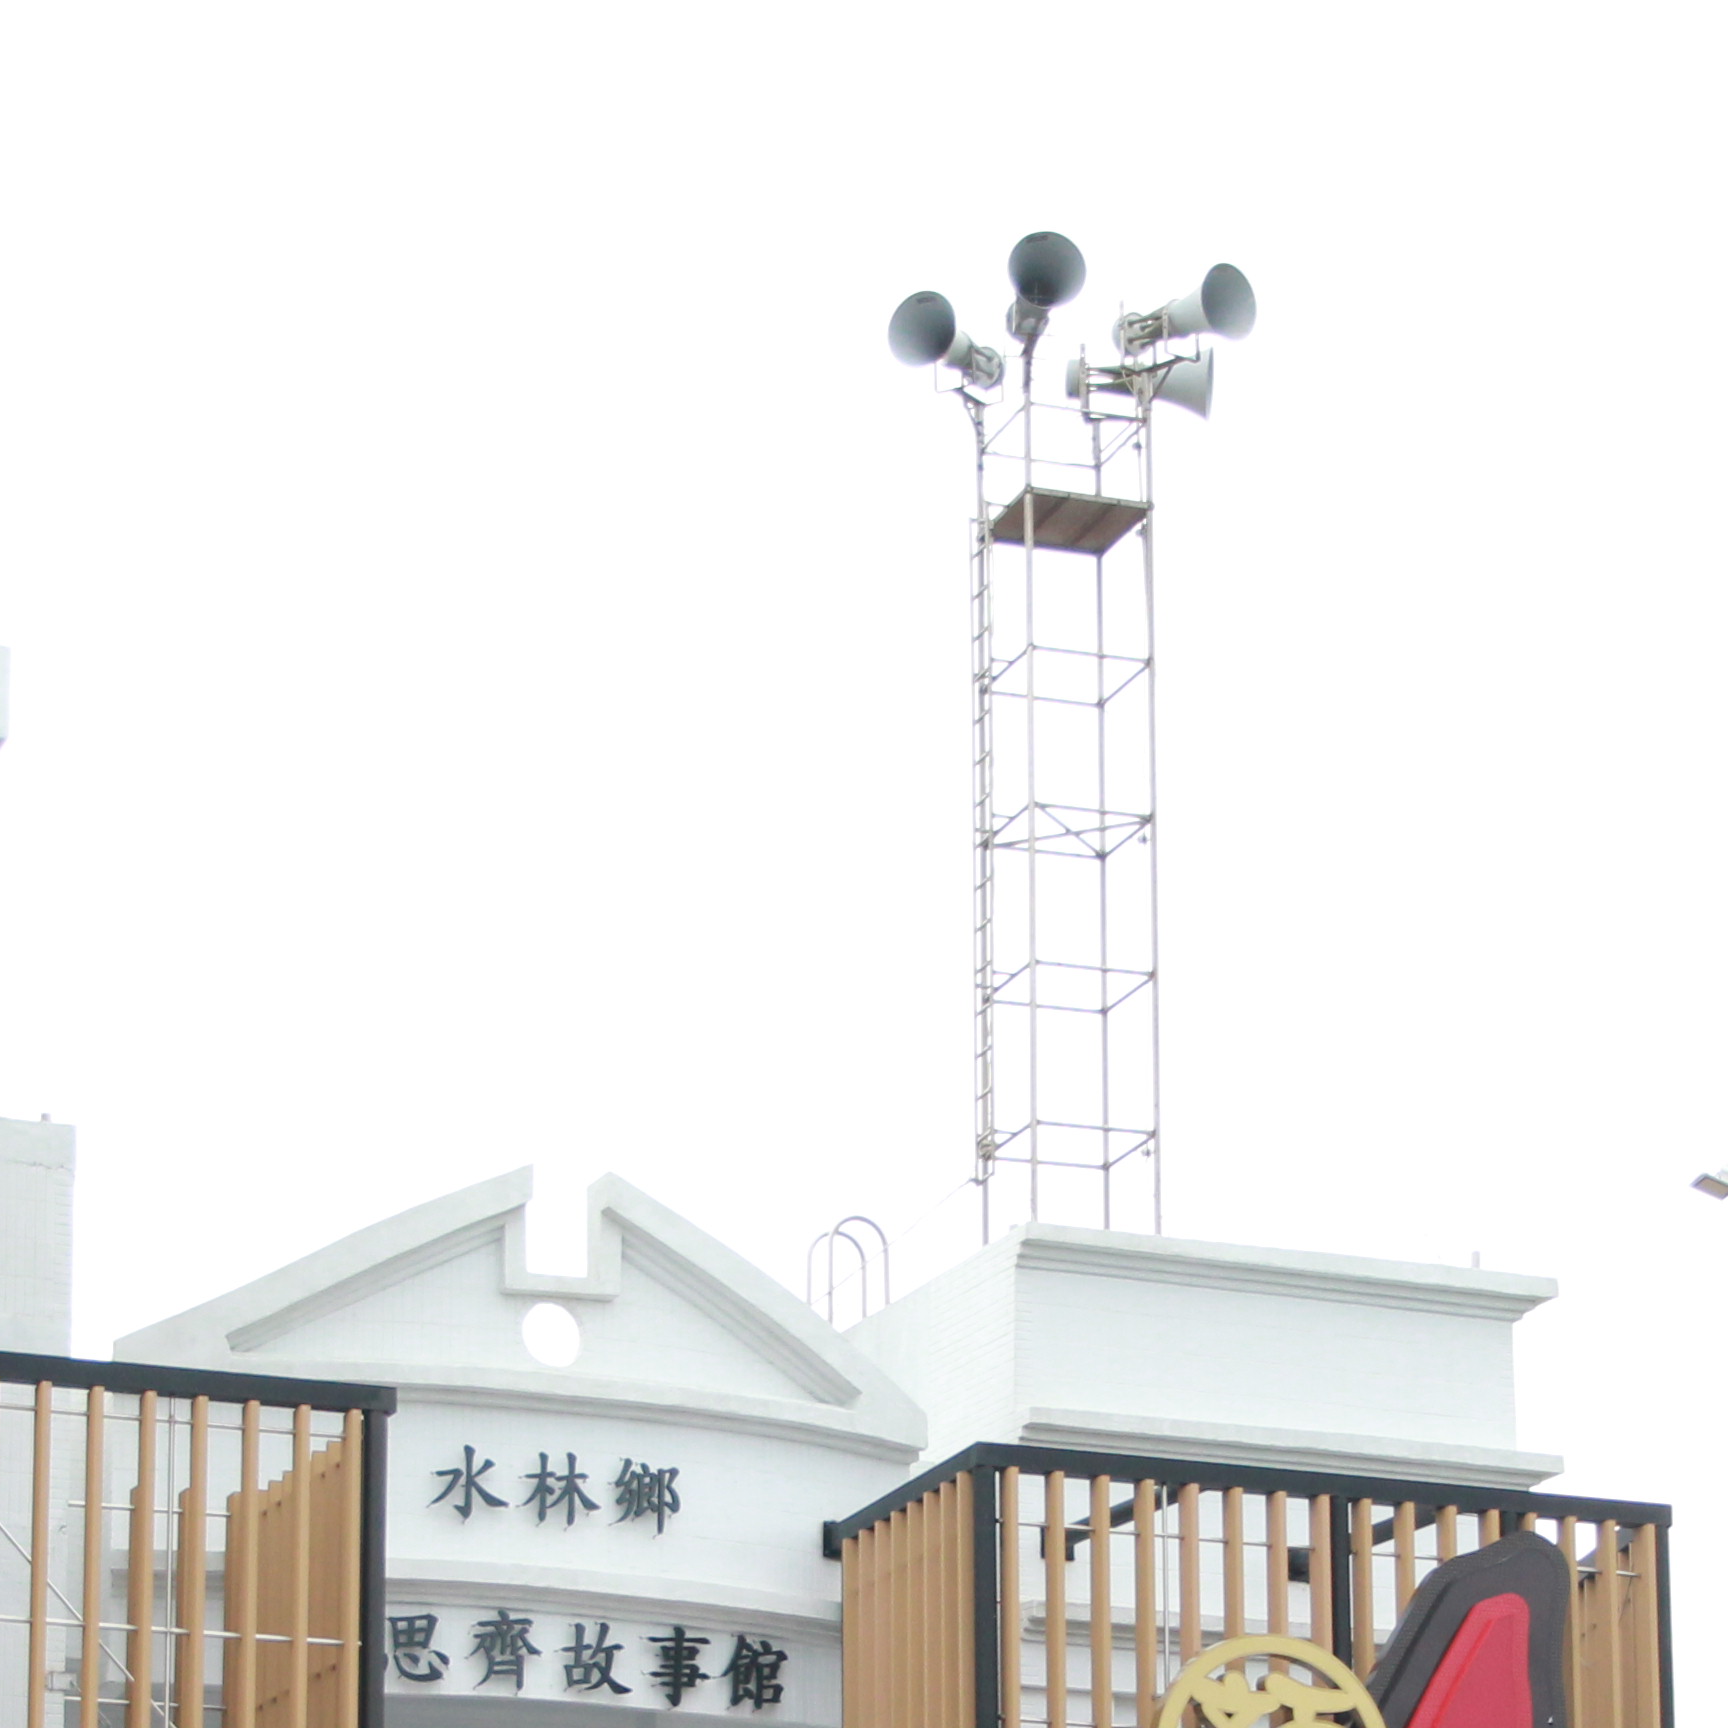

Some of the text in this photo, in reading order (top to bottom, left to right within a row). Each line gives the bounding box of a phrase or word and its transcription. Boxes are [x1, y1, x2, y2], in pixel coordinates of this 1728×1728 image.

[427, 1445, 681, 1537] 水林鄉
[385, 1609, 788, 1711] 思齊故事館
